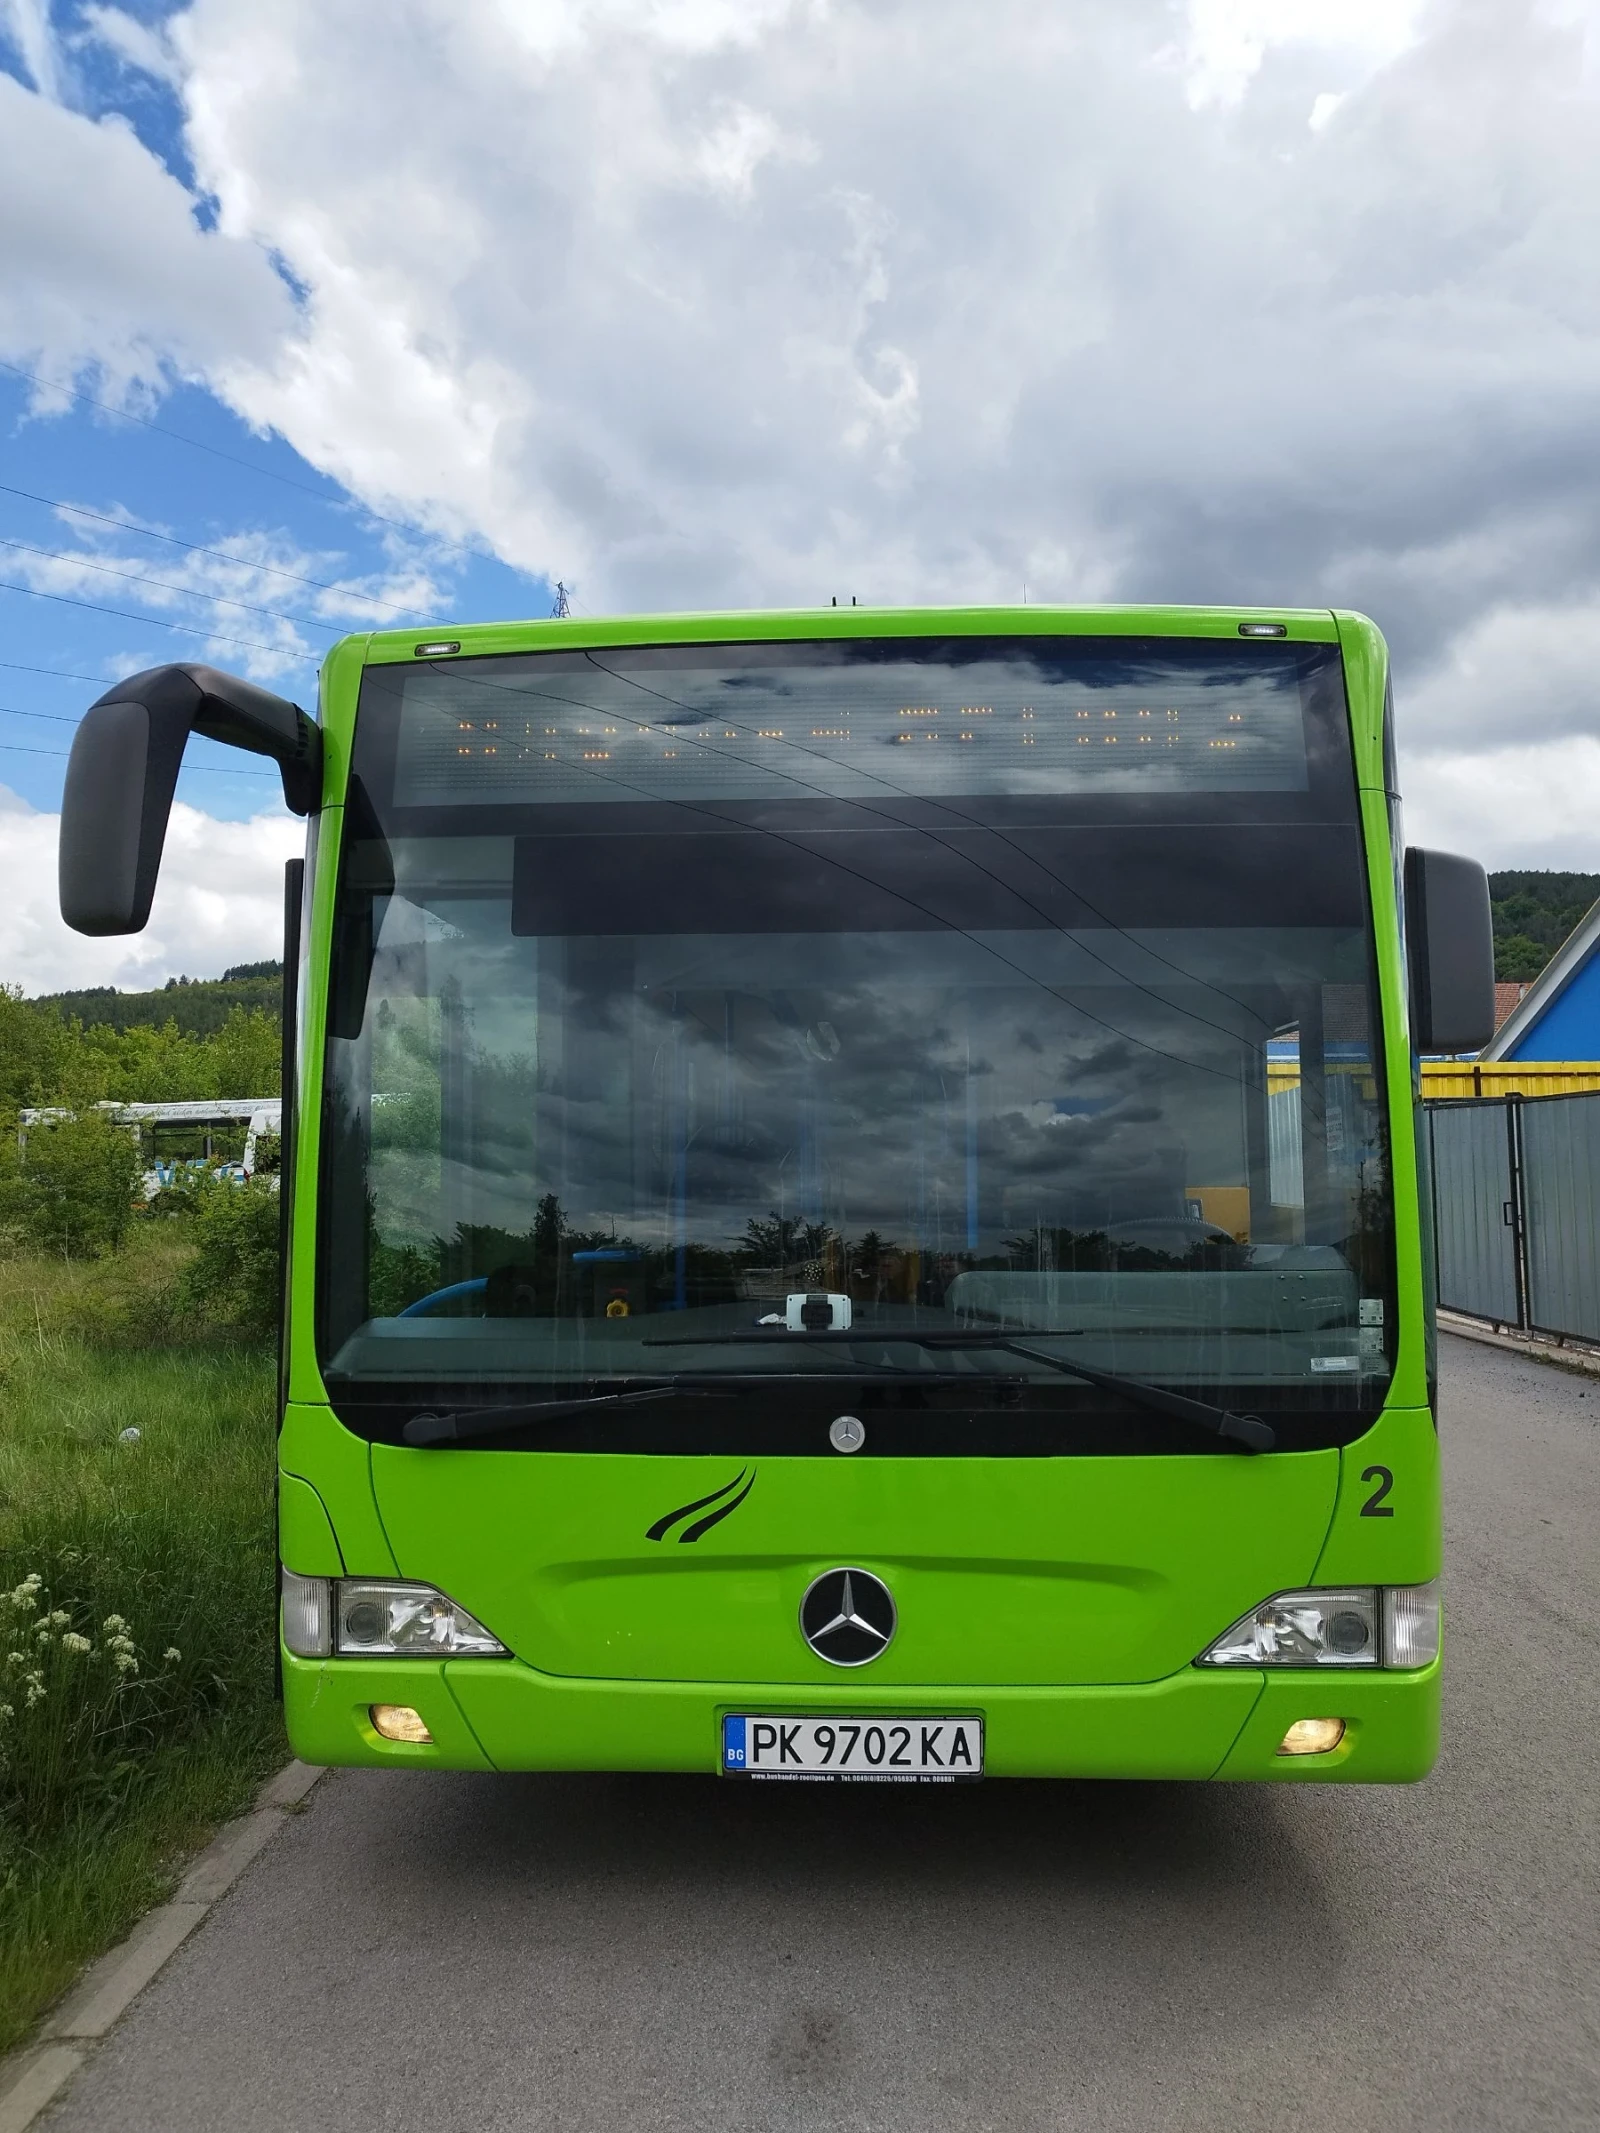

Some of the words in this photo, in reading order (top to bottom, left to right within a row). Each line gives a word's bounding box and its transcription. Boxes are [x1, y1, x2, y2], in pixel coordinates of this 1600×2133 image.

[1360, 1465, 1394, 1517] 2
[727, 1748, 744, 1761] BG
[753, 1723, 803, 1764] PK
[814, 1725, 911, 1766] 9702
[921, 1726, 972, 1766] KA
